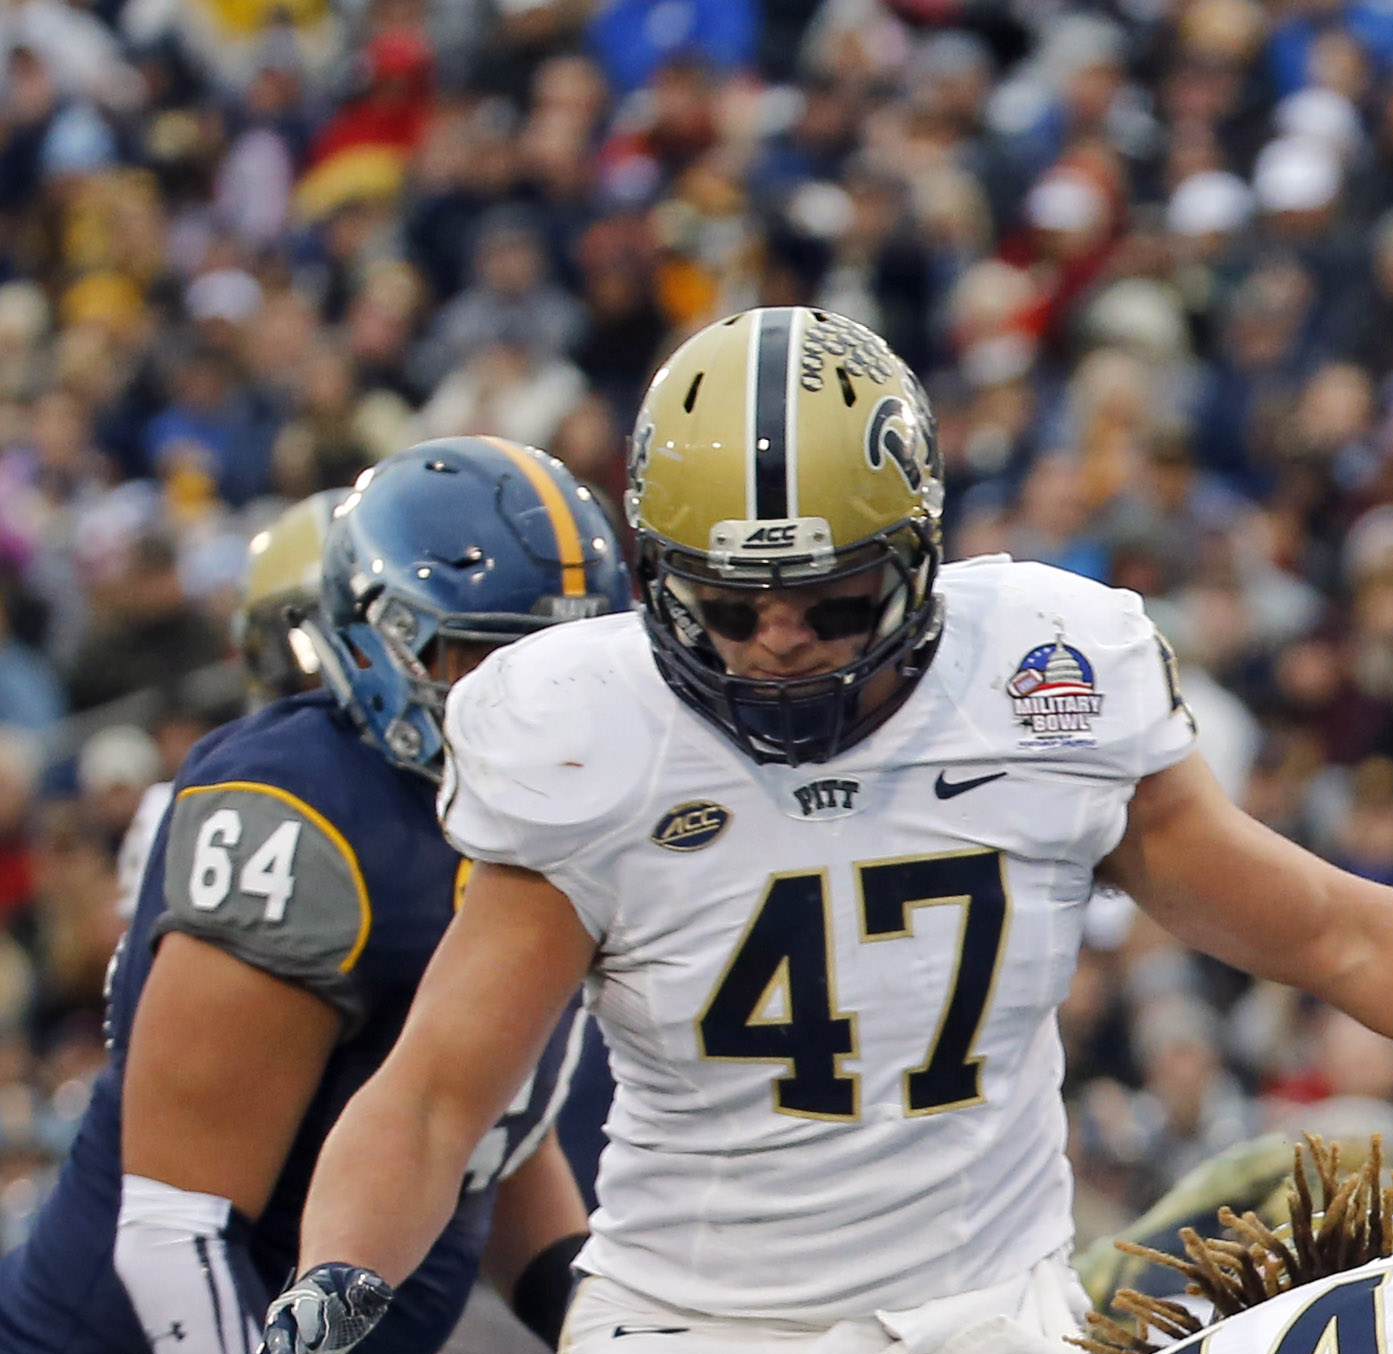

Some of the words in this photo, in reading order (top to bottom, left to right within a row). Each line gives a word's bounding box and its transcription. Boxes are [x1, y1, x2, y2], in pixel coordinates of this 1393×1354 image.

[745, 524, 798, 550] ACC
[1013, 695, 1102, 715] MILITARY
[1033, 713, 1091, 732] BOWL
[793, 778, 860, 817] PITT
[660, 806, 722, 840] ACC
[188, 808, 303, 923] 64
[693, 845, 1014, 1123] 47
